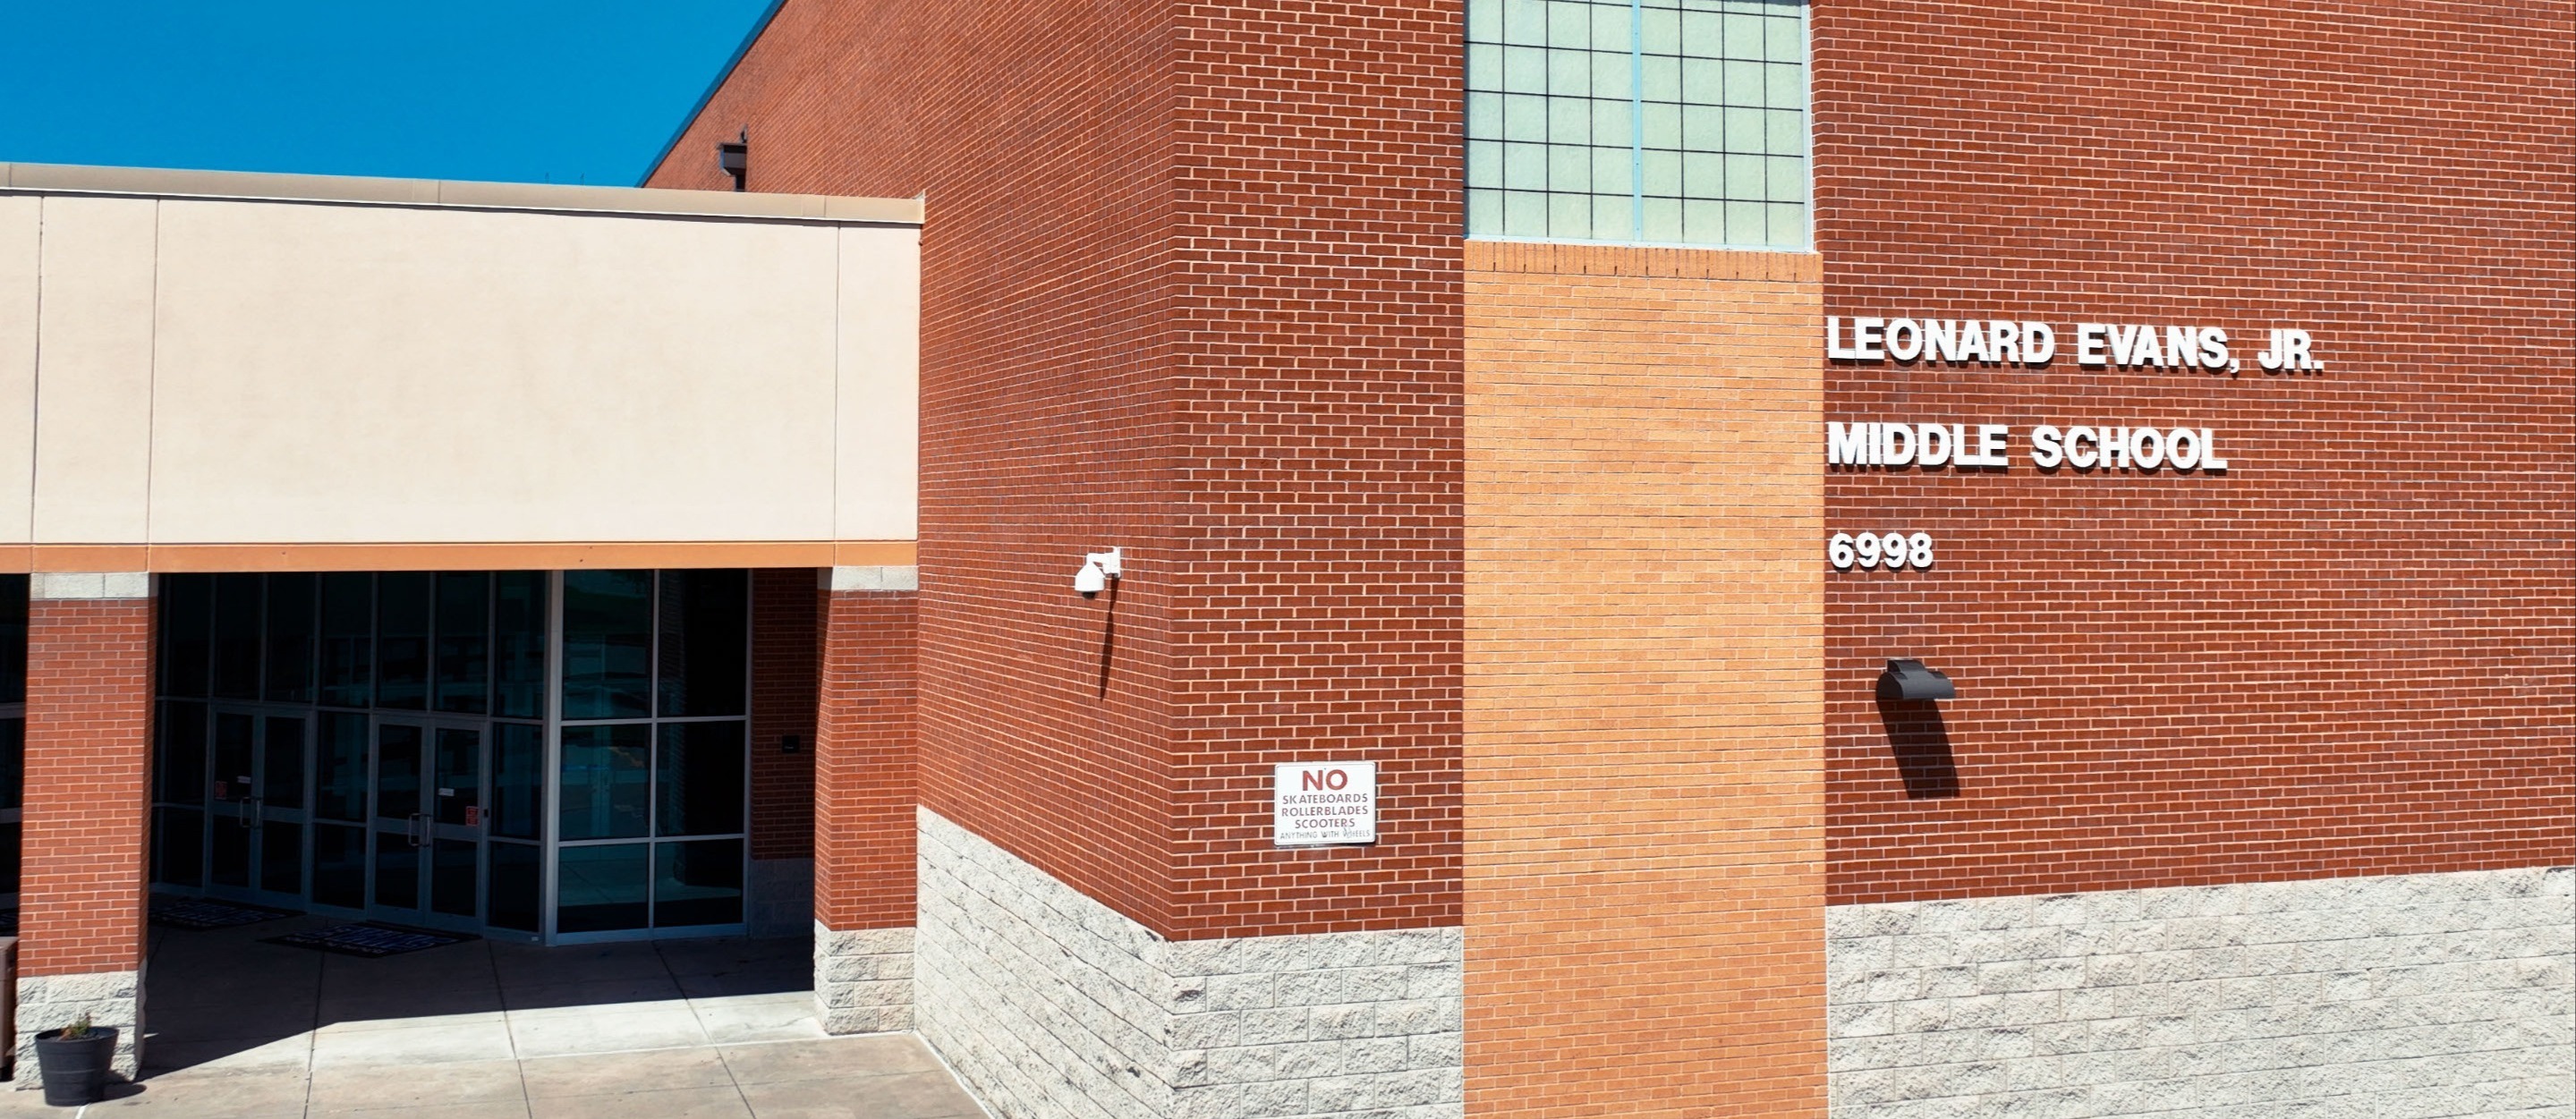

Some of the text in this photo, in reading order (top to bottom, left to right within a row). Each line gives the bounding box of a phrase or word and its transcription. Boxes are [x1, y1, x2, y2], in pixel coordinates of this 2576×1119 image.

[1827, 316, 2325, 374] LEONARD EVANS, JR.
[1827, 421, 2227, 470] MIDDLE SCHOOL
[1828, 532, 1934, 569] 6998
[1303, 769, 1348, 791] NO
[1282, 793, 1368, 804] SKATEBOARDS
[1281, 805, 1368, 817] ROLLERBLADES
[1295, 818, 1356, 828] SCOOTERS
[1280, 831, 1318, 839] ANYTHING
[1321, 830, 1339, 838] WITH
